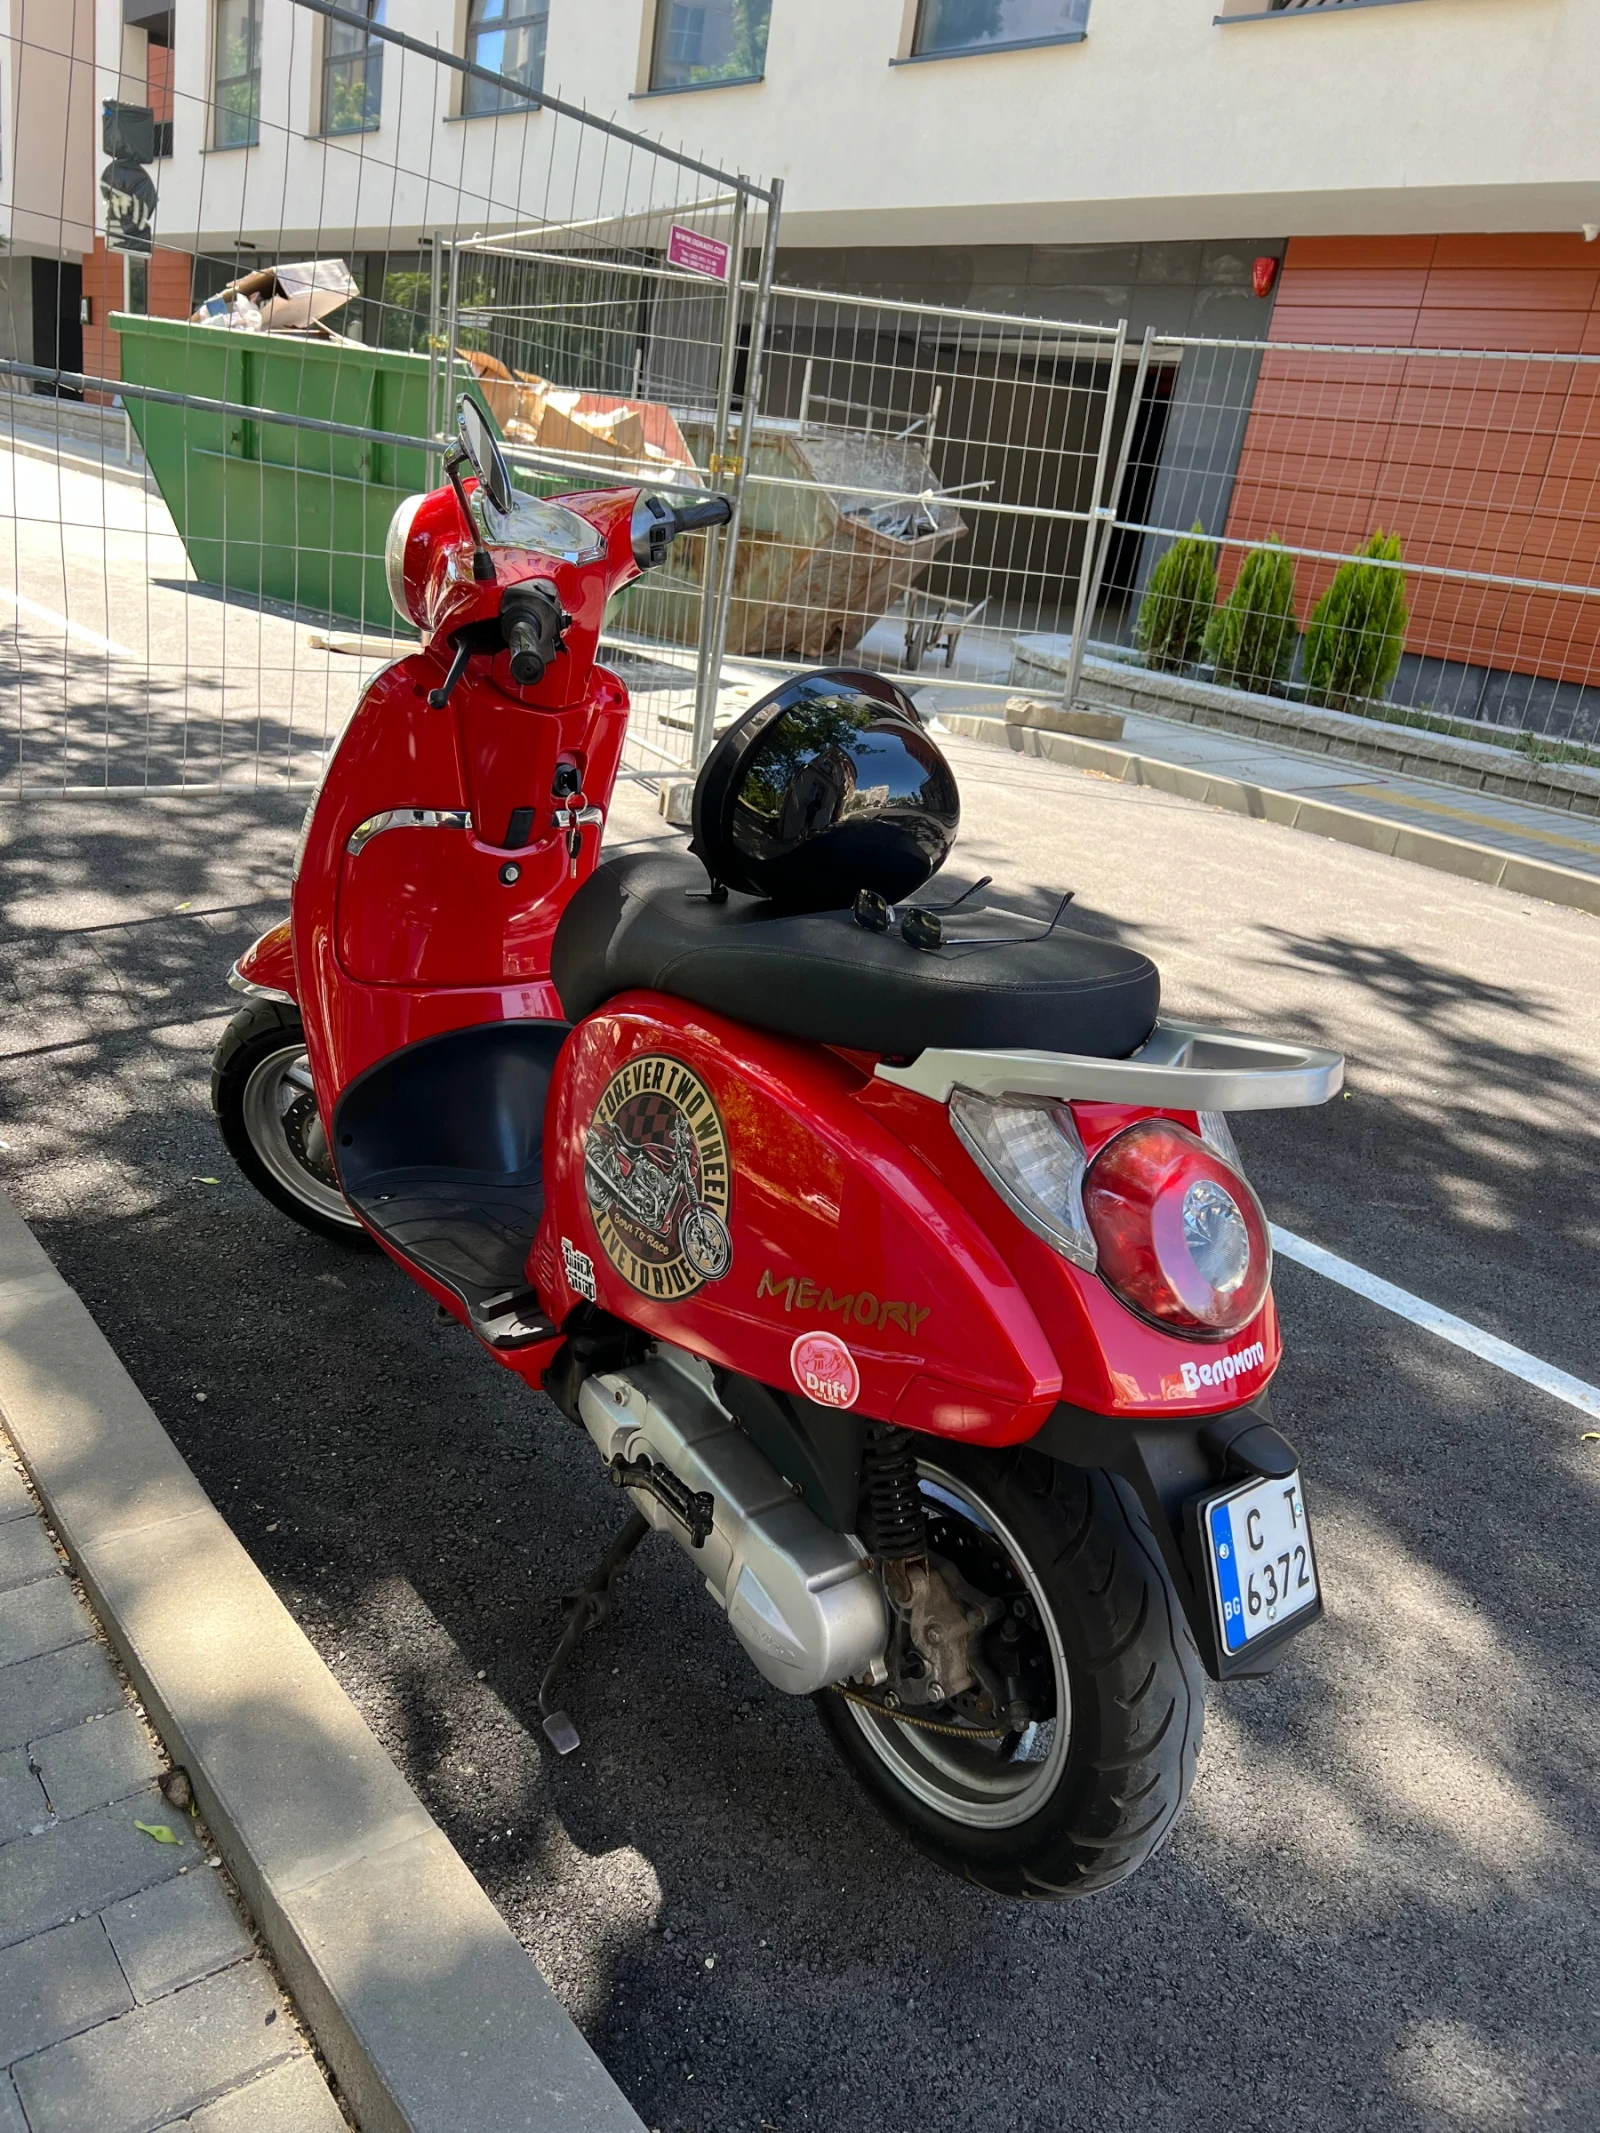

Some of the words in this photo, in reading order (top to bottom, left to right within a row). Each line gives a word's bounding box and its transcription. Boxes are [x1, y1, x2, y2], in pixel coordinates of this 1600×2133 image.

[598, 1061, 666, 1121] FOREVER
[665, 1066, 706, 1119] TWO
[595, 1209, 628, 1271] LIVE
[629, 1255, 650, 1291] TO
[652, 1257, 697, 1295] RIDE
[613, 1212, 633, 1234] Born
[634, 1226, 646, 1241] To
[646, 1234, 670, 1256] Race
[756, 1267, 931, 1337] MEMORY
[806, 1371, 848, 1401] Drift
[1247, 1508, 1264, 1551] C
[1283, 1486, 1297, 1530] T
[1224, 1597, 1241, 1621] BG
[1247, 1545, 1310, 1617] 6372
